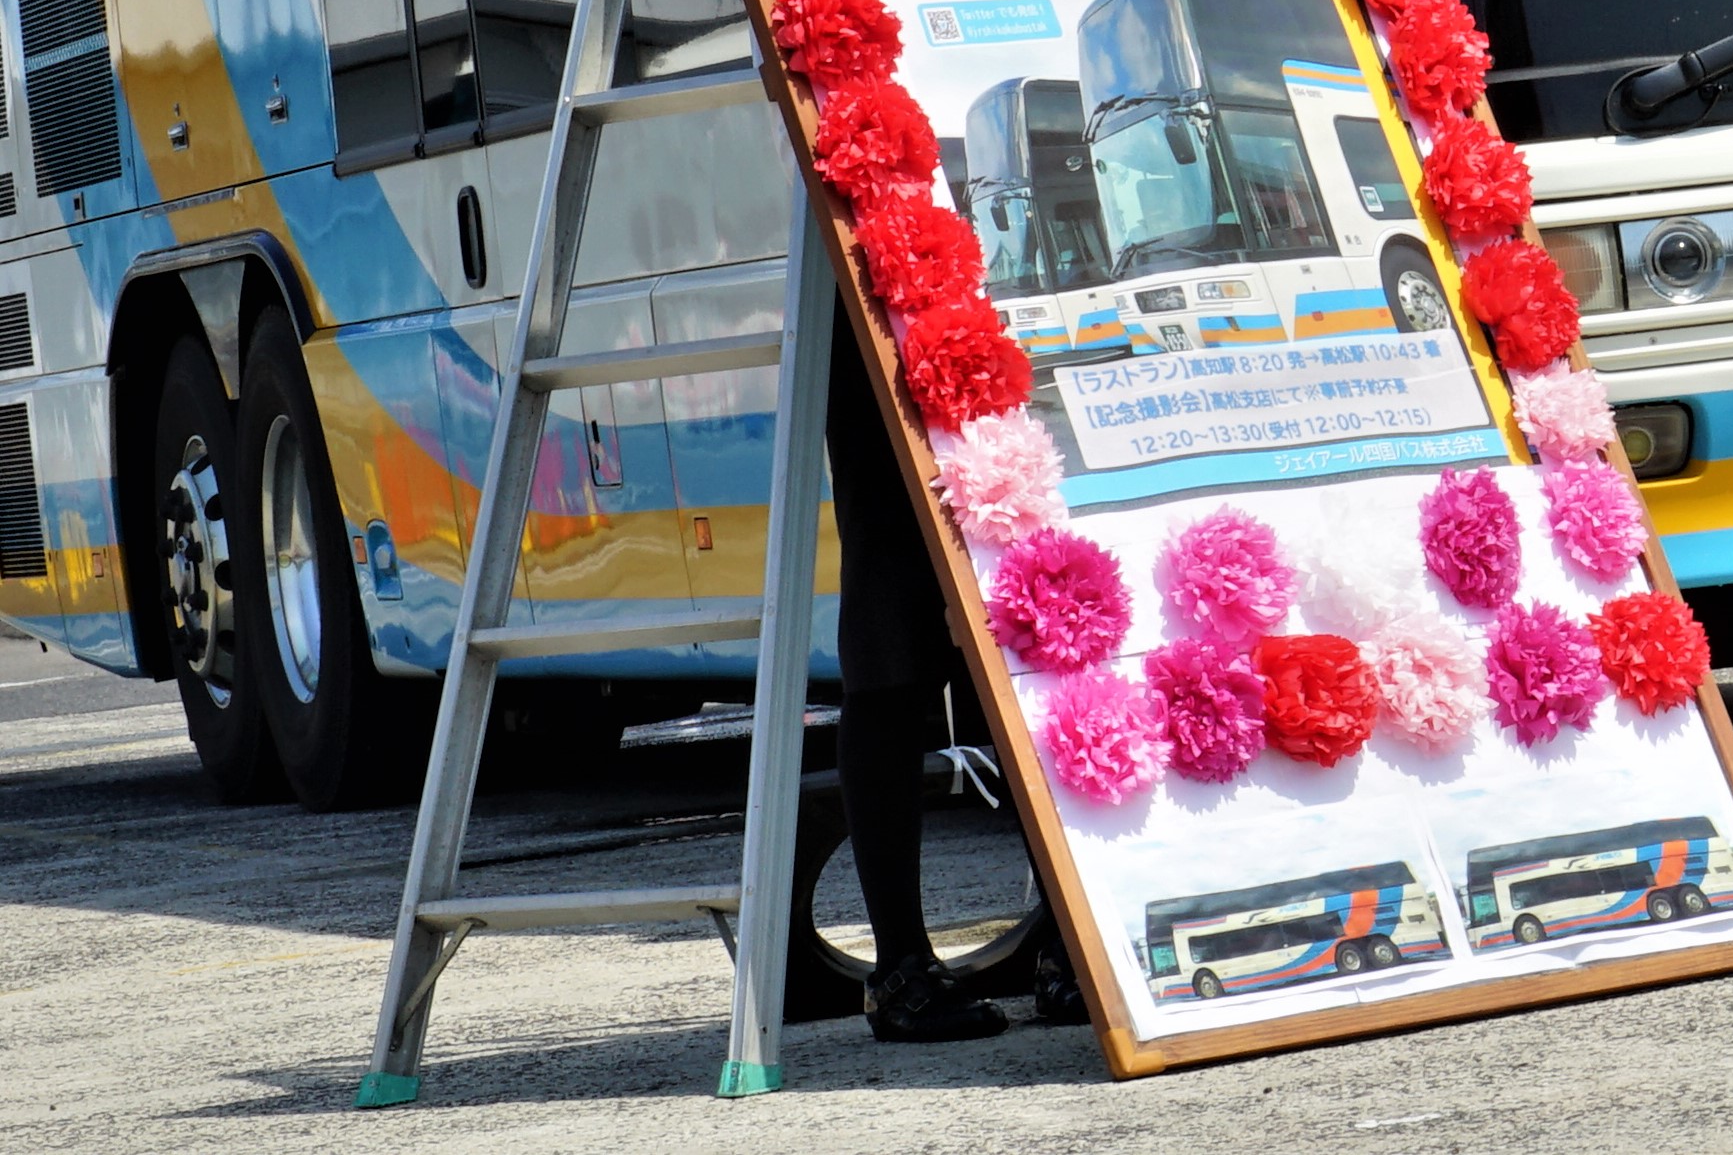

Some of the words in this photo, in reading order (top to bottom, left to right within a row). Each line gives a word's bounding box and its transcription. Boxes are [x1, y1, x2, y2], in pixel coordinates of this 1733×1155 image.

[1274, 435, 1489, 473] ジェイアール四国バス株式会社
